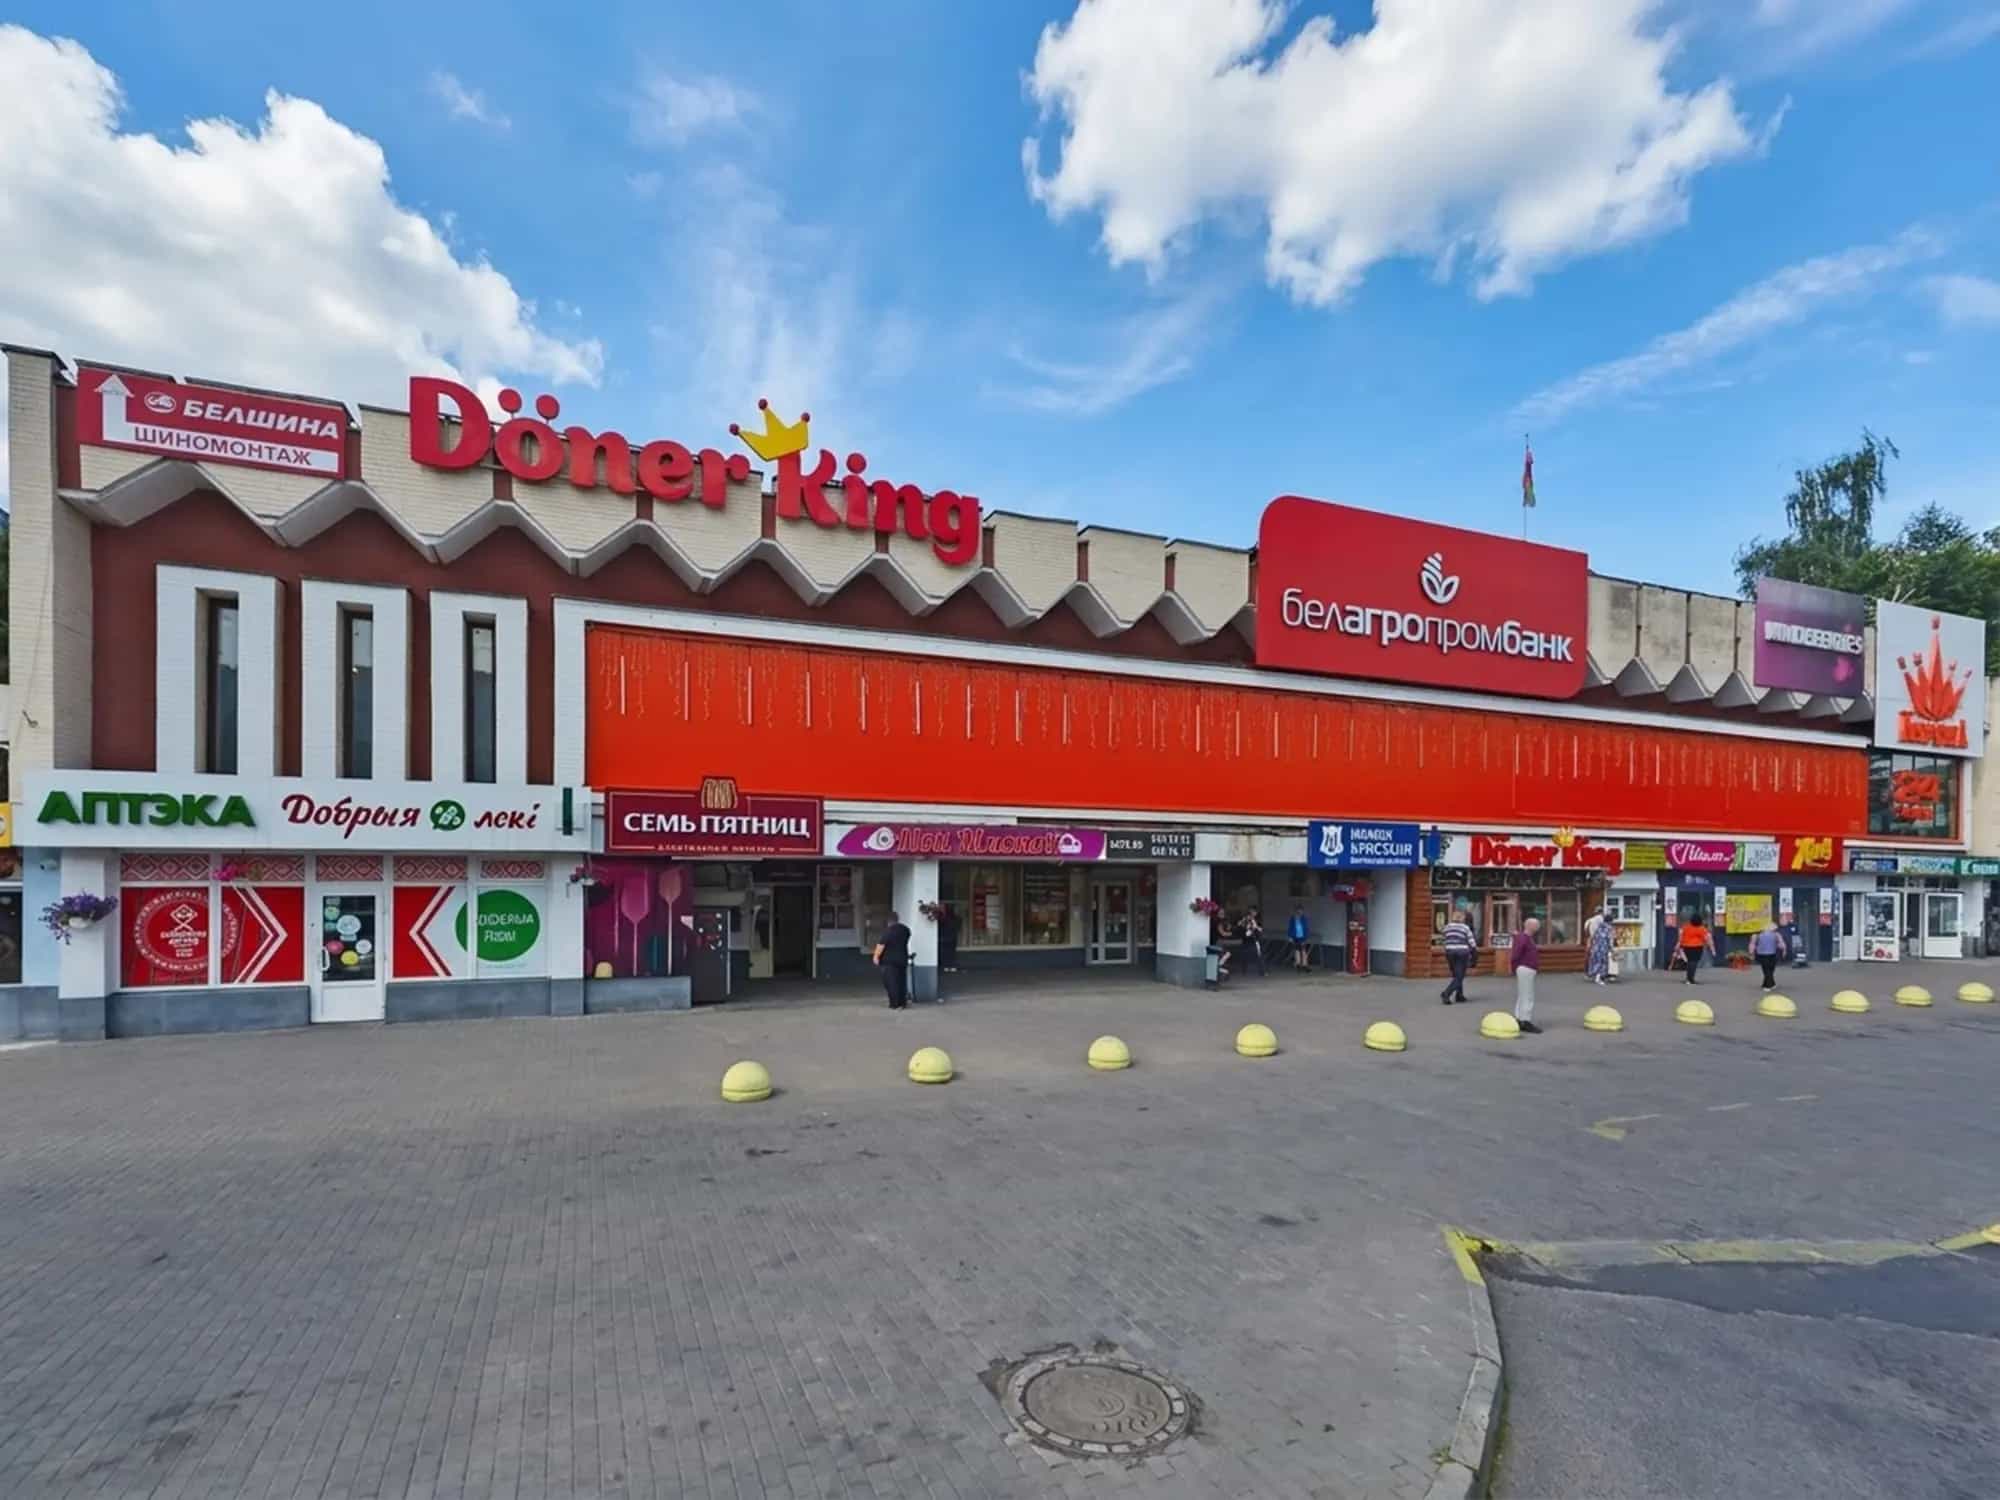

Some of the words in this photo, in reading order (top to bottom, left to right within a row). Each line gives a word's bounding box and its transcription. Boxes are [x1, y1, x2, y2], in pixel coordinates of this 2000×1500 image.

[183, 399, 339, 439] БЕЛШИНА
[134, 426, 312, 466] ШИНОМОНТАЖ
[410, 376, 751, 509] Döner
[776, 447, 981, 566] King
[1281, 587, 1575, 662] белагропромбанк
[37, 790, 257, 828] АПТЭКА
[281, 793, 421, 839] Добрыя
[623, 811, 697, 833] СЕМЬ
[700, 814, 811, 838] ПЯТНИЦ
